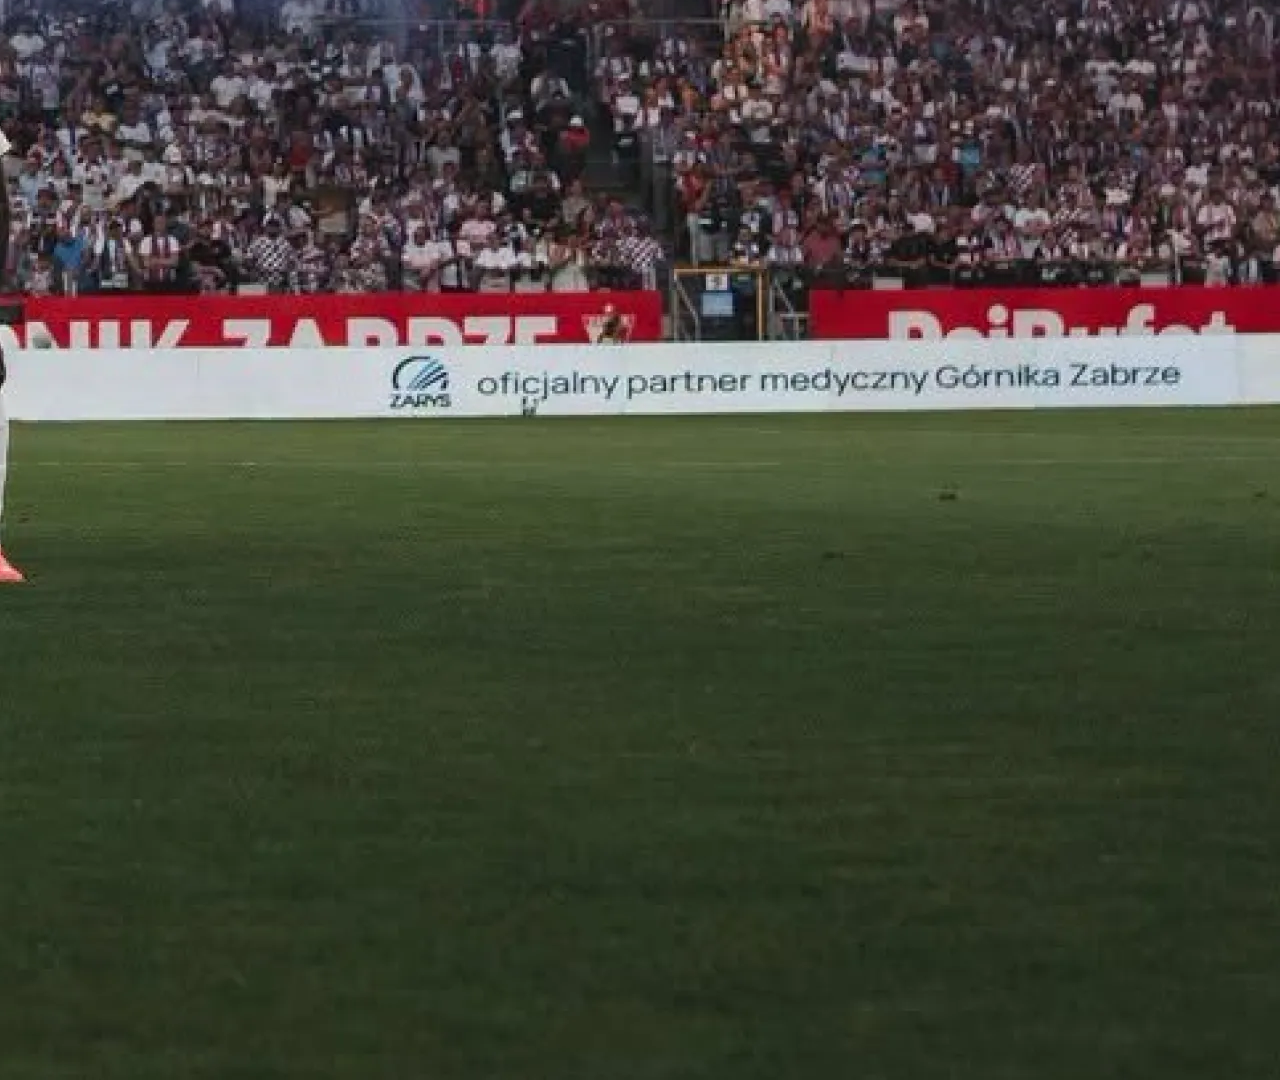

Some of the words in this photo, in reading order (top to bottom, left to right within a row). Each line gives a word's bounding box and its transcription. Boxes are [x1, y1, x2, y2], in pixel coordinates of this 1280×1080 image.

[477, 370, 619, 400] oficjalny
[626, 371, 752, 401] partner
[760, 367, 929, 398] medyczny
[935, 364, 1060, 389] Górnika
[1068, 362, 1181, 387] Zabrze
[390, 394, 452, 408] ZARYS
